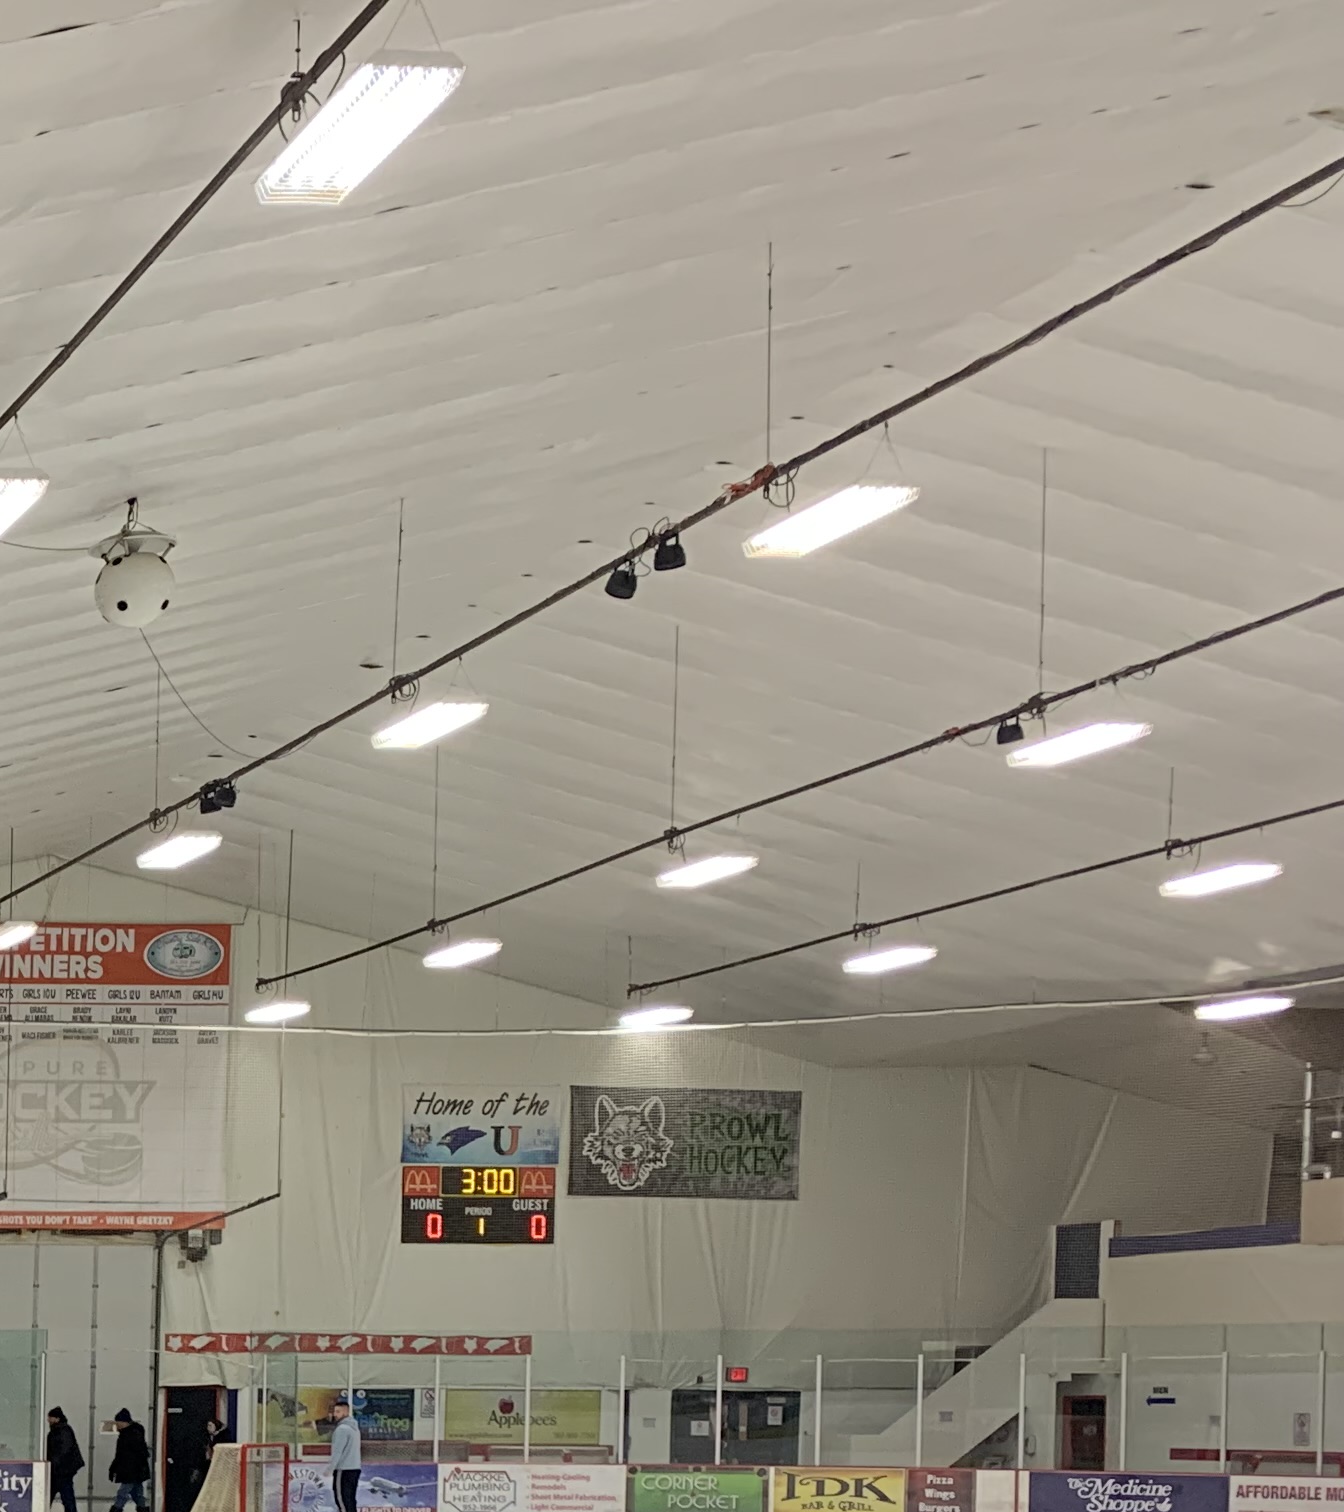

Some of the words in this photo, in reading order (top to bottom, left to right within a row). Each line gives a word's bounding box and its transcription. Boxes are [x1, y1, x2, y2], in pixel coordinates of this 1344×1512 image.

[22, 989, 41, 1000] GIRLS
[65, 989, 97, 1000] PEEWEE
[108, 990, 127, 1000] GIRLS
[150, 990, 182, 1000] BANTAM
[193, 991, 211, 1000] GIRLS
[23, 1061, 108, 1075] PURE
[413, 1092, 474, 1116] Home
[482, 1092, 509, 1118] of
[513, 1092, 550, 1116] the
[689, 1111, 791, 1142] PROWL
[688, 1144, 789, 1176] HOCKEY
[462, 1168, 514, 1194] 3:00
[410, 1198, 443, 1210] HOME
[512, 1198, 549, 1210] GUEST
[465, 1206, 492, 1216] PERIOD
[26, 1216, 43, 1225] YOU
[426, 1213, 443, 1239] 0
[478, 1217, 485, 1237] 1
[530, 1214, 547, 1240] 0
[452, 1472, 506, 1481] MACKKE
[641, 1474, 718, 1491] CORNER
[926, 1474, 954, 1485] Pizza
[449, 1482, 511, 1492] PLUMBING
[531, 1483, 567, 1491] Remodels
[781, 1471, 896, 1505] IDK
[924, 1487, 956, 1500] Wings
[1077, 1477, 1173, 1499] Medicine
[1236, 1485, 1322, 1501] AFFORDABLE
[452, 1495, 507, 1504] HEATING
[667, 1494, 739, 1509] POCKET
[530, 1504, 549, 1512] Light
[550, 1504, 594, 1512] Commercial
[801, 1501, 824, 1510] BAR
[827, 1501, 834, 1510] &
[838, 1501, 875, 1512] GRILL
